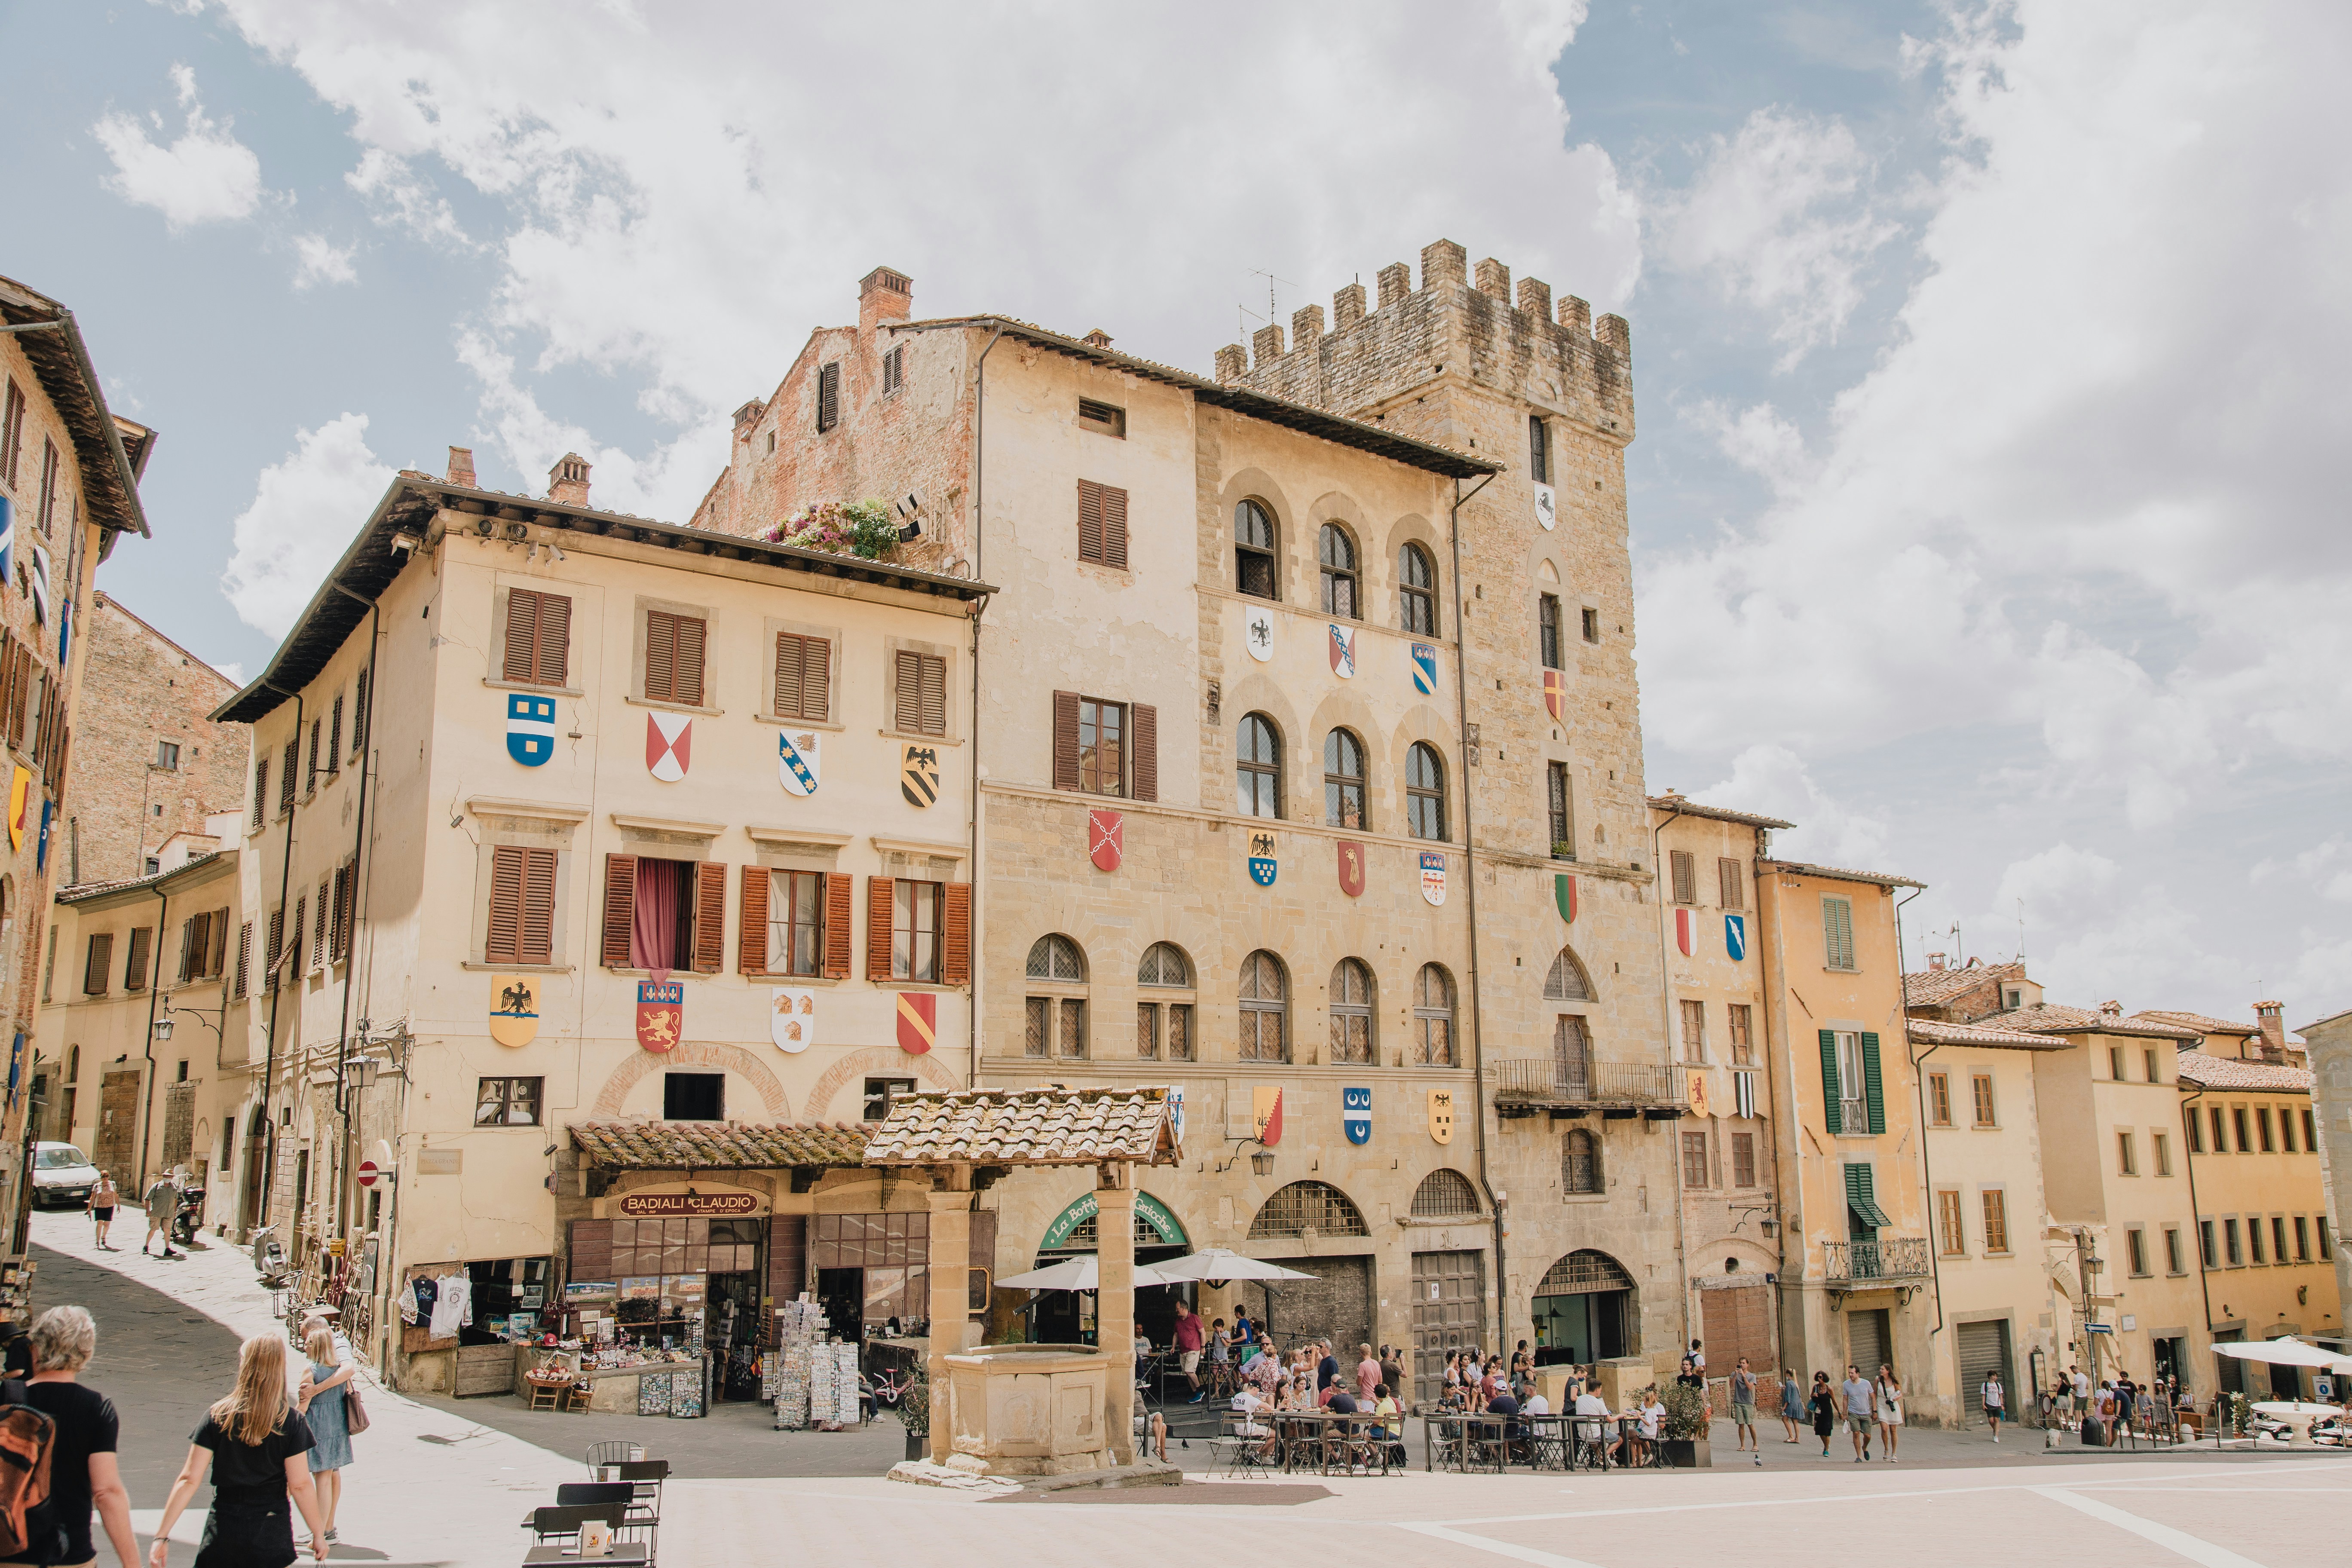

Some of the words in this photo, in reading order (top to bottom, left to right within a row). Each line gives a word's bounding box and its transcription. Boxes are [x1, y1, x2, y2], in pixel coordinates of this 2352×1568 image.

[628, 1197, 684, 1209] BADIALI
[691, 1197, 750, 1208] CLAUDIO
[1051, 1219, 1069, 1238] La
[1068, 1197, 1099, 1222] Botte
[1134, 1198, 1170, 1233] Gnicche
